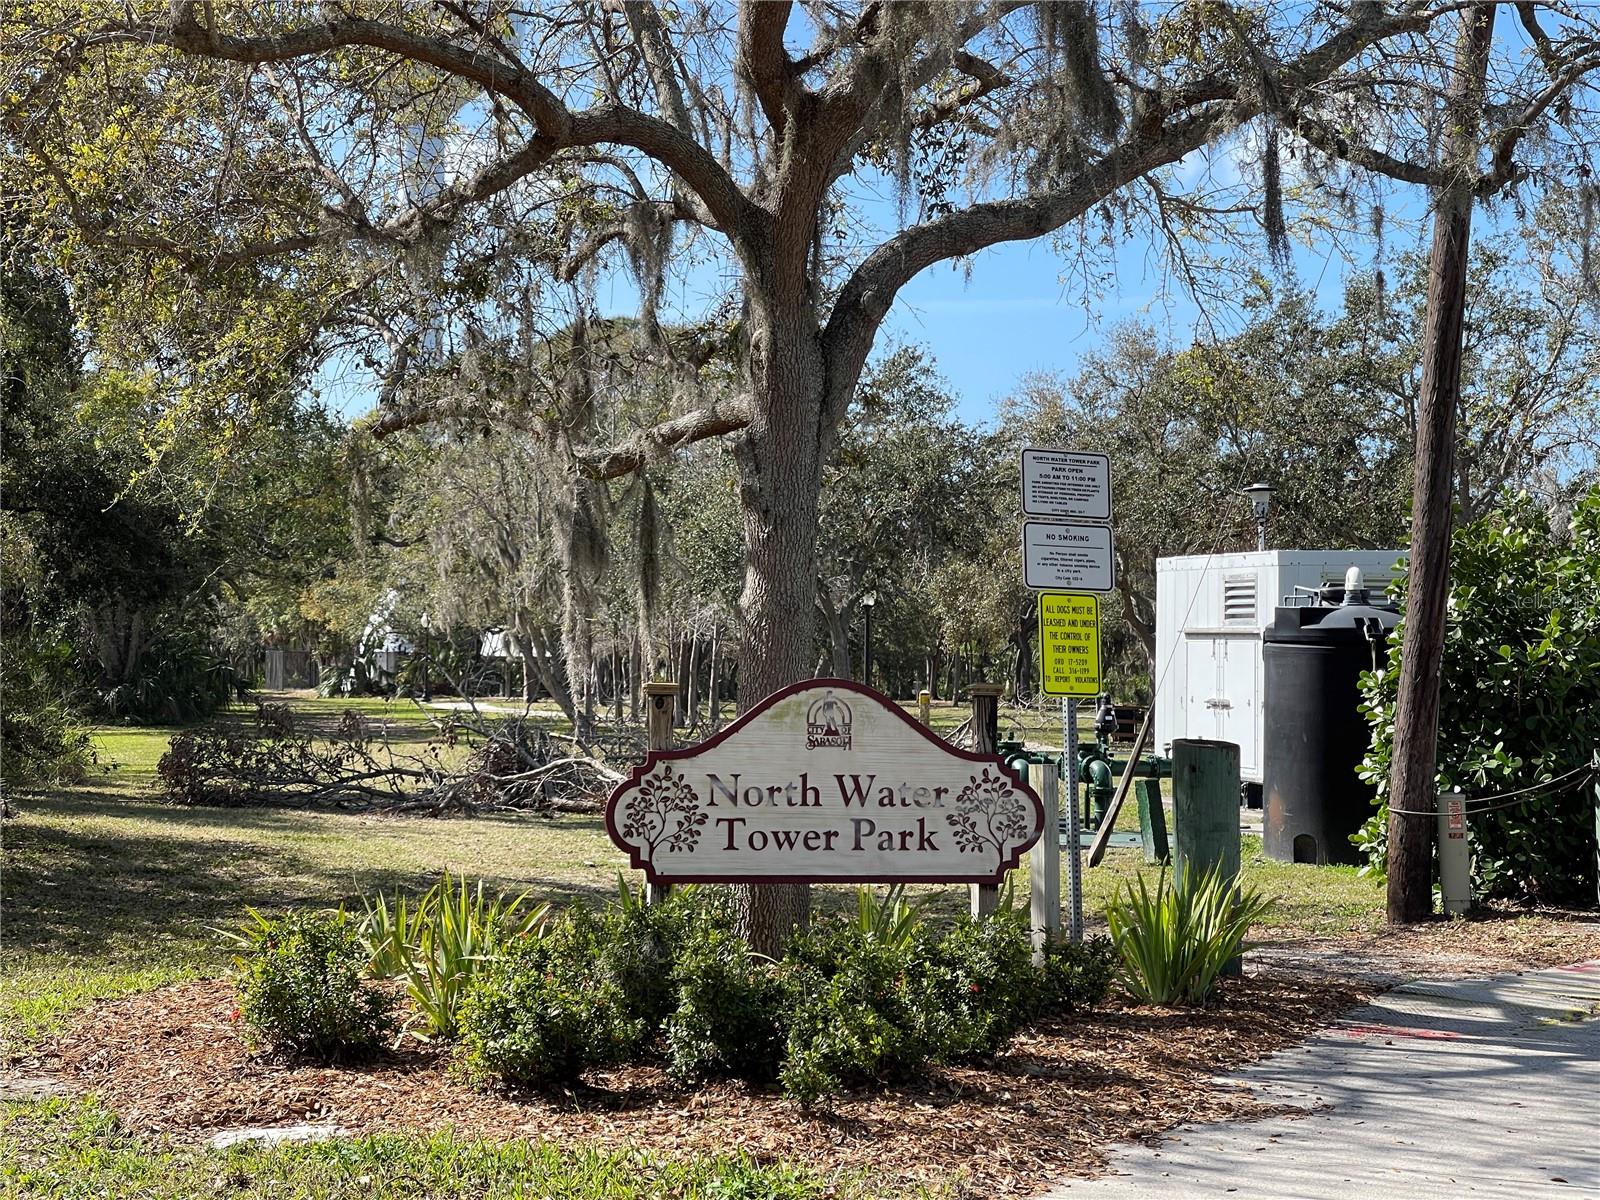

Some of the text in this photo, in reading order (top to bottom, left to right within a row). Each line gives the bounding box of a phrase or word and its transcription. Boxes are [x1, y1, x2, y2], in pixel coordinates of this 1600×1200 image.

[1046, 605, 1055, 614] ALL
[1057, 606, 1070, 614] DOGS
[1044, 618, 1066, 627] LEASHED
[1050, 632, 1058, 640] THE
[1060, 632, 1082, 640] CONTROL
[1053, 645, 1089, 654] THEIR OWNERS
[841, 726, 851, 735] OF
[706, 773, 949, 808] North Water
[716, 817, 940, 852] Tower Park
